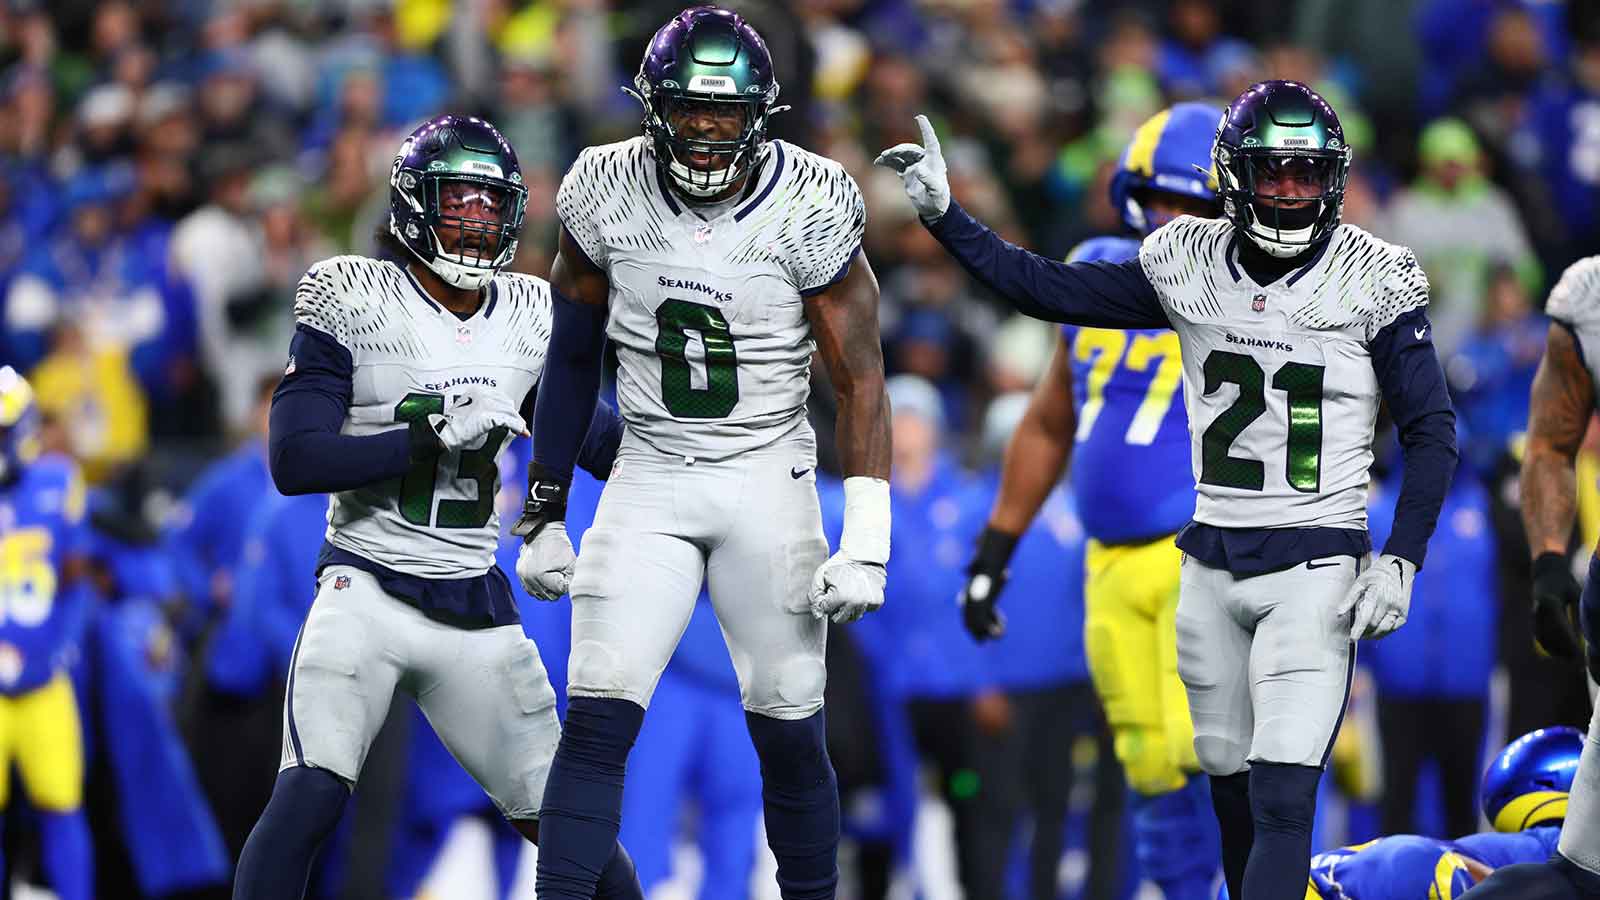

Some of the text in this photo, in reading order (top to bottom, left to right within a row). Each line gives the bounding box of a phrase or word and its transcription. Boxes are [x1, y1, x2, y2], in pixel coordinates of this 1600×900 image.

[658, 276, 733, 303] SEAHAWKS
[655, 298, 740, 418] 0
[1225, 333, 1294, 352] SEAHAWKS
[425, 377, 497, 391] SEAHAWKS
[1075, 328, 1183, 445] 77
[1199, 349, 1326, 493] 21
